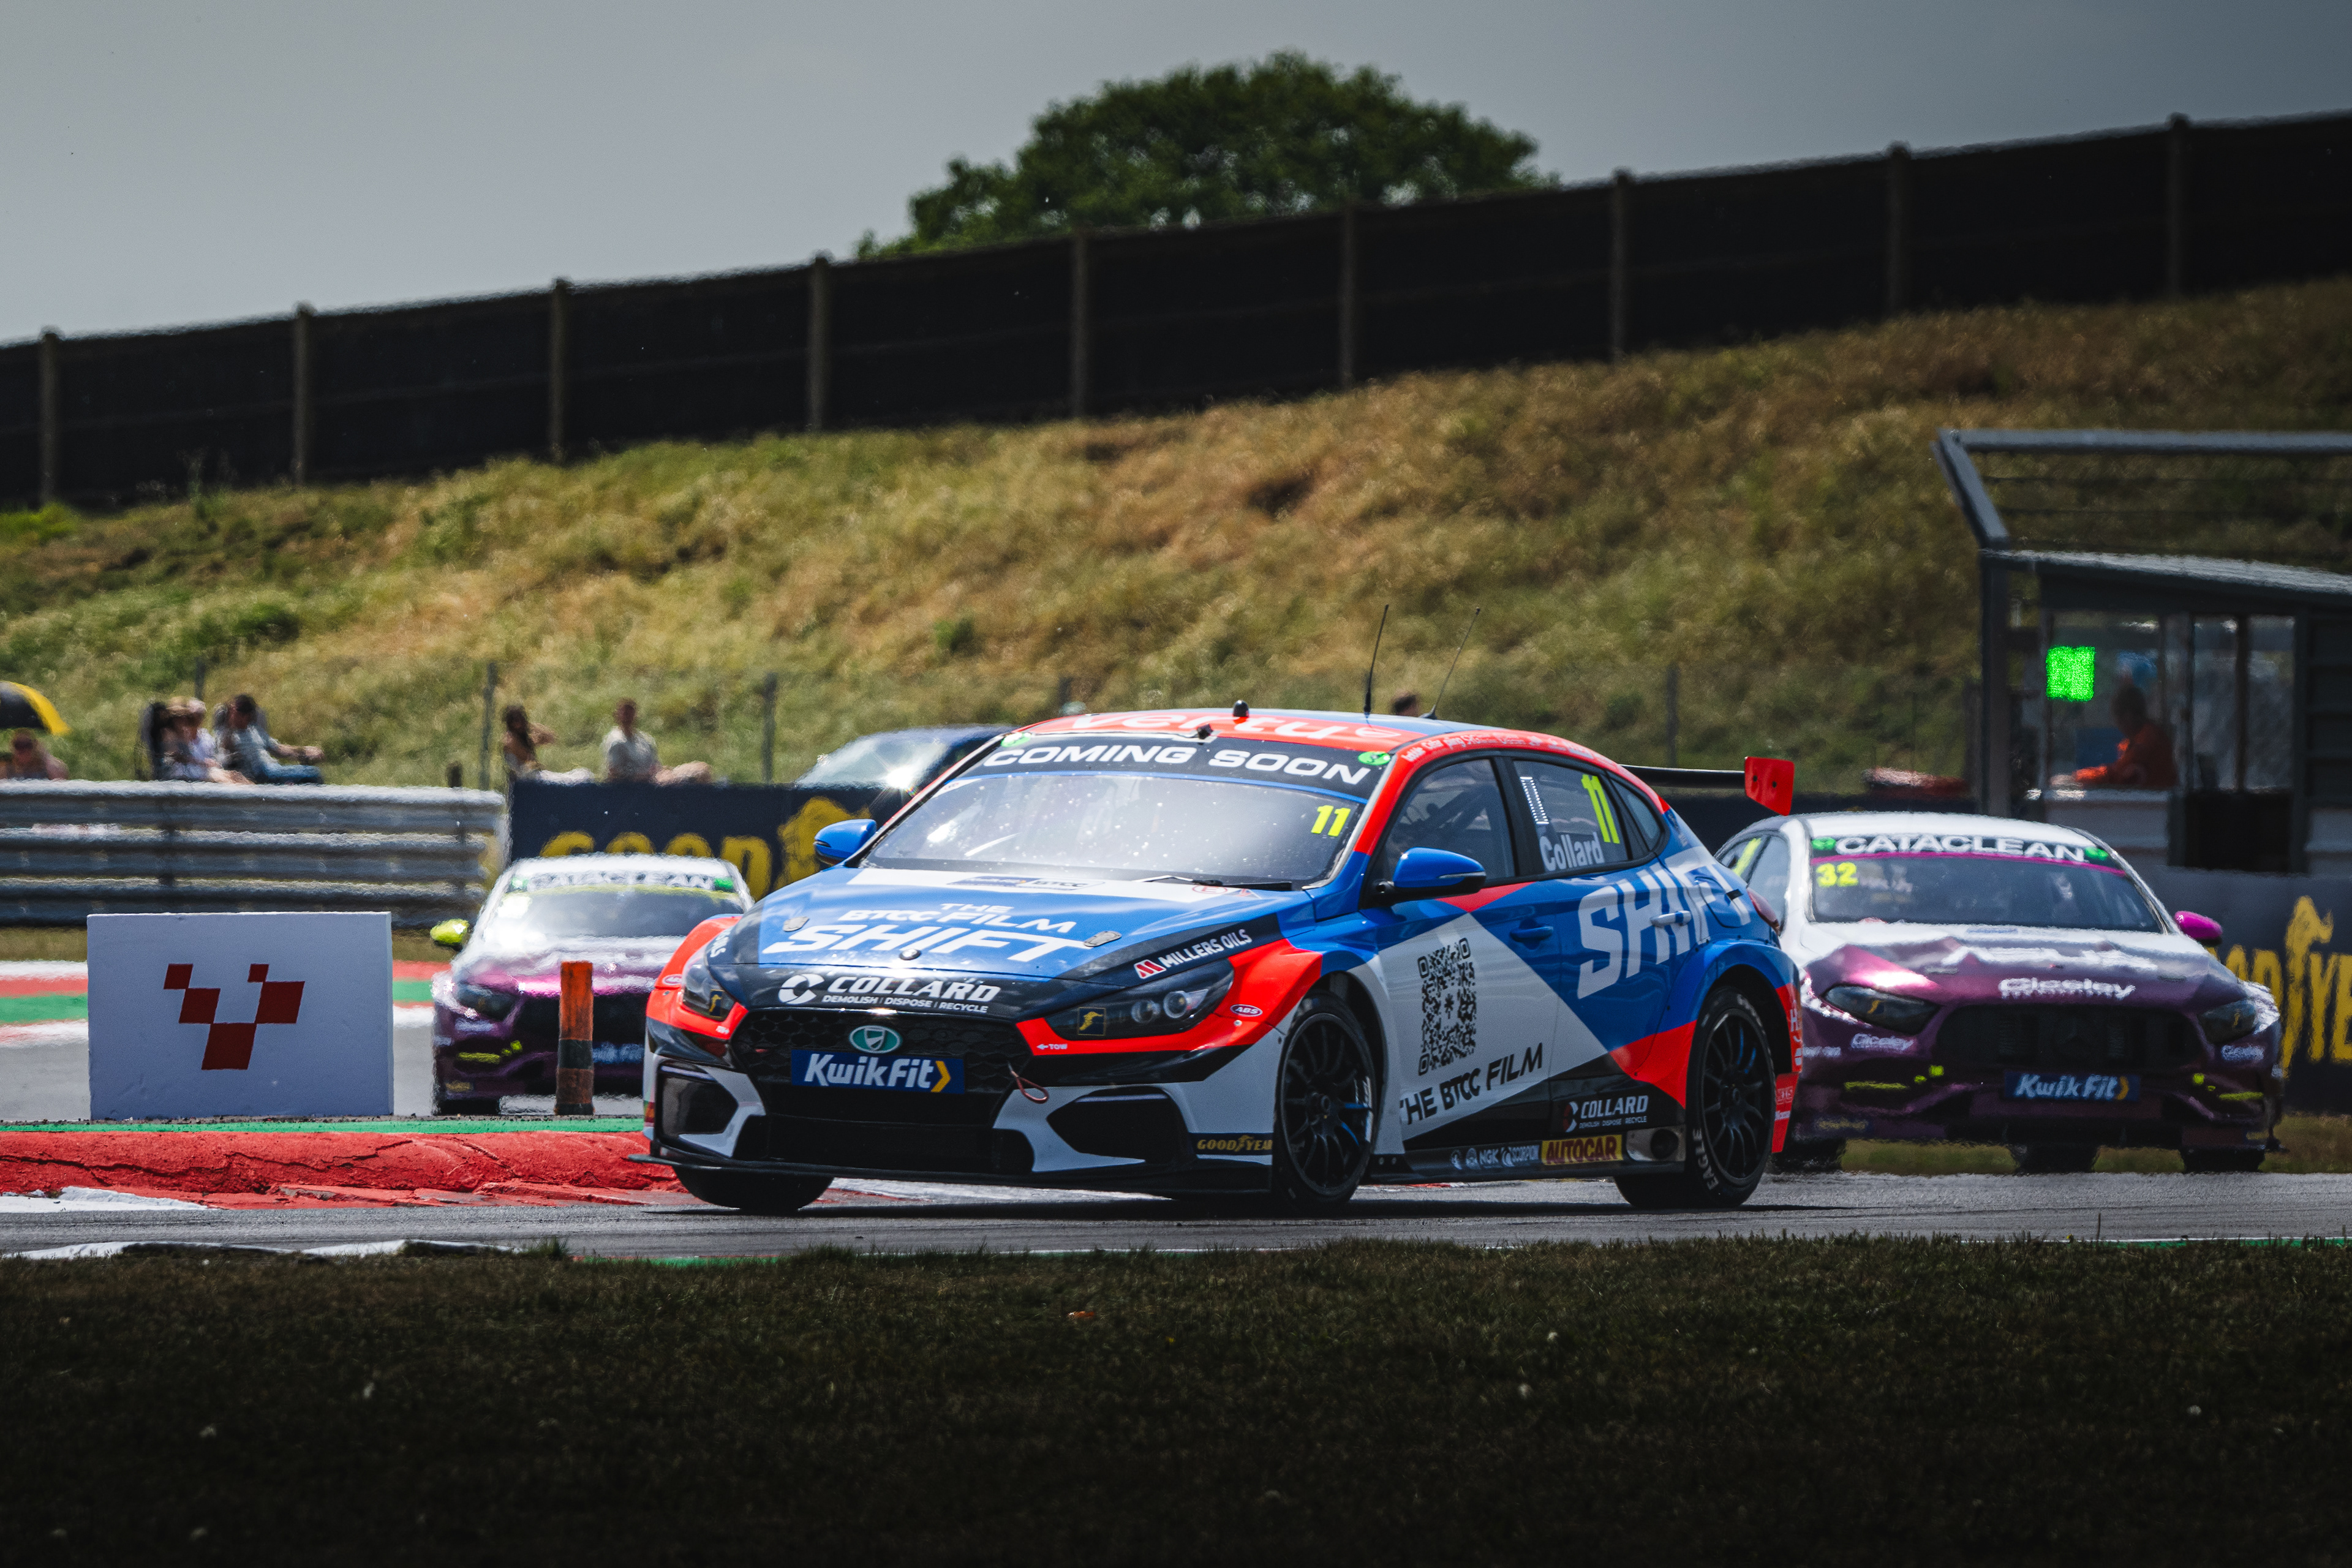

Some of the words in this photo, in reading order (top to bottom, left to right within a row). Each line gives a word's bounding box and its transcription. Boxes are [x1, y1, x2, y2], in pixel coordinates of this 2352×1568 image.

[983, 745, 1197, 767] COMING
[1208, 750, 1371, 785] SOON
[1311, 805, 1351, 837] 11
[1585, 774, 1620, 844] 11
[1539, 831, 1605, 872] Collard
[1836, 835, 2084, 862] CATACLEAN
[1816, 861, 1858, 888] 32
[837, 910, 941, 922] BTCC
[937, 912, 1077, 933] FILM
[941, 903, 1014, 913] THE
[1577, 846, 1751, 999] SHIFT
[761, 924, 1095, 962] SHIFT
[1158, 938, 1224, 968] MILLERS
[1220, 929, 1253, 949] OILS
[827, 976, 1001, 1002] COLLARD
[821, 995, 878, 1005] DEMOLISH
[884, 997, 932, 1008] DISPOSE
[938, 1002, 989, 1014] RECYCLE
[1400, 1087, 1438, 1125] HE
[1439, 1067, 1481, 1110] BTCC
[1486, 1042, 1543, 1091] FILM
[1580, 1095, 1649, 1119] COLLARD
[1625, 1115, 1648, 1125] RECYCLE
[1479, 1148, 1499, 1165] NGK
[1545, 1136, 1618, 1164] AUTOCAR
